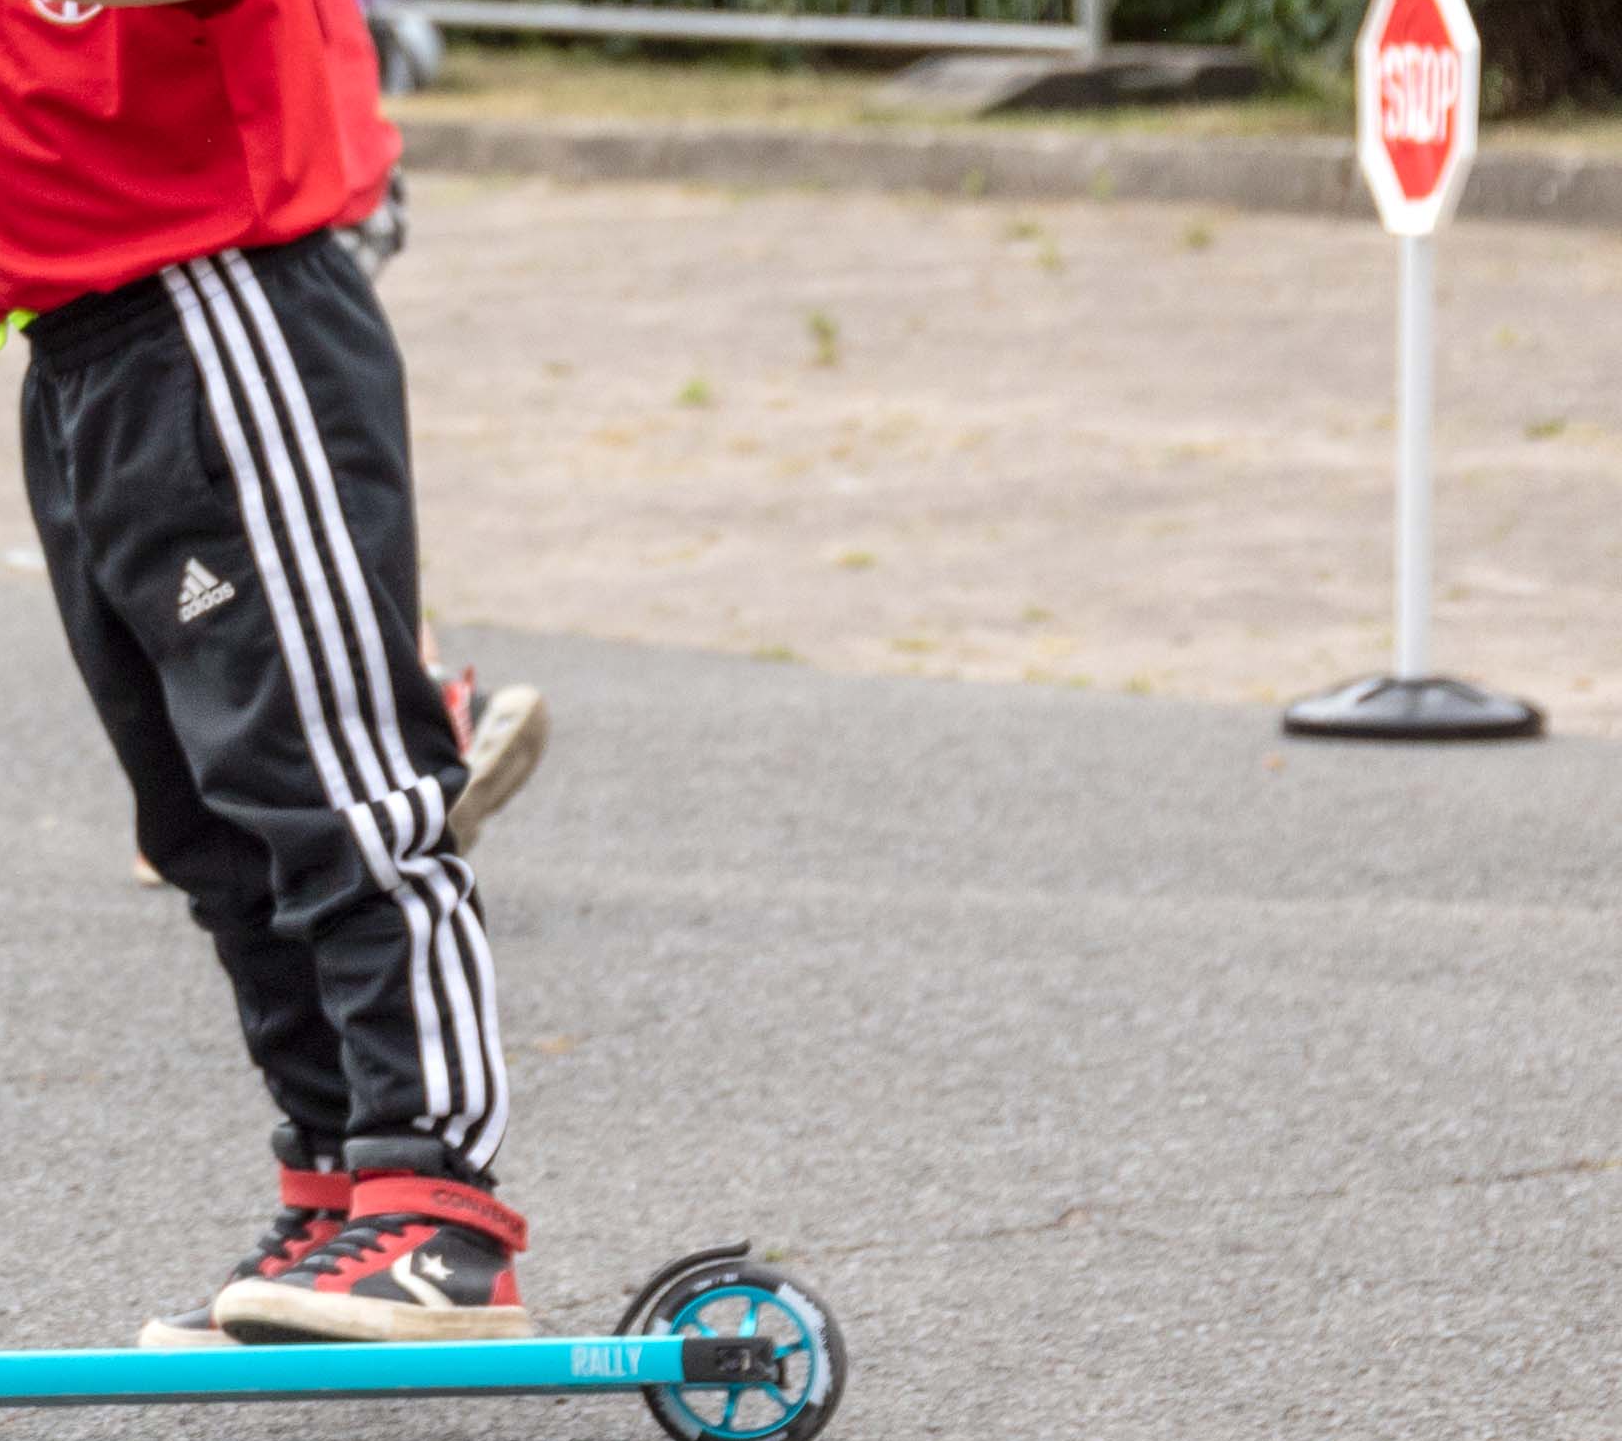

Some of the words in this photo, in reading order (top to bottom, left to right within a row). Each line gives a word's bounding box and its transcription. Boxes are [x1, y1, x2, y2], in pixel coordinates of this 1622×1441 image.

[1382, 44, 1457, 143] STOP
[178, 581, 235, 623] adidas
[571, 1344, 643, 1377] RALLY
